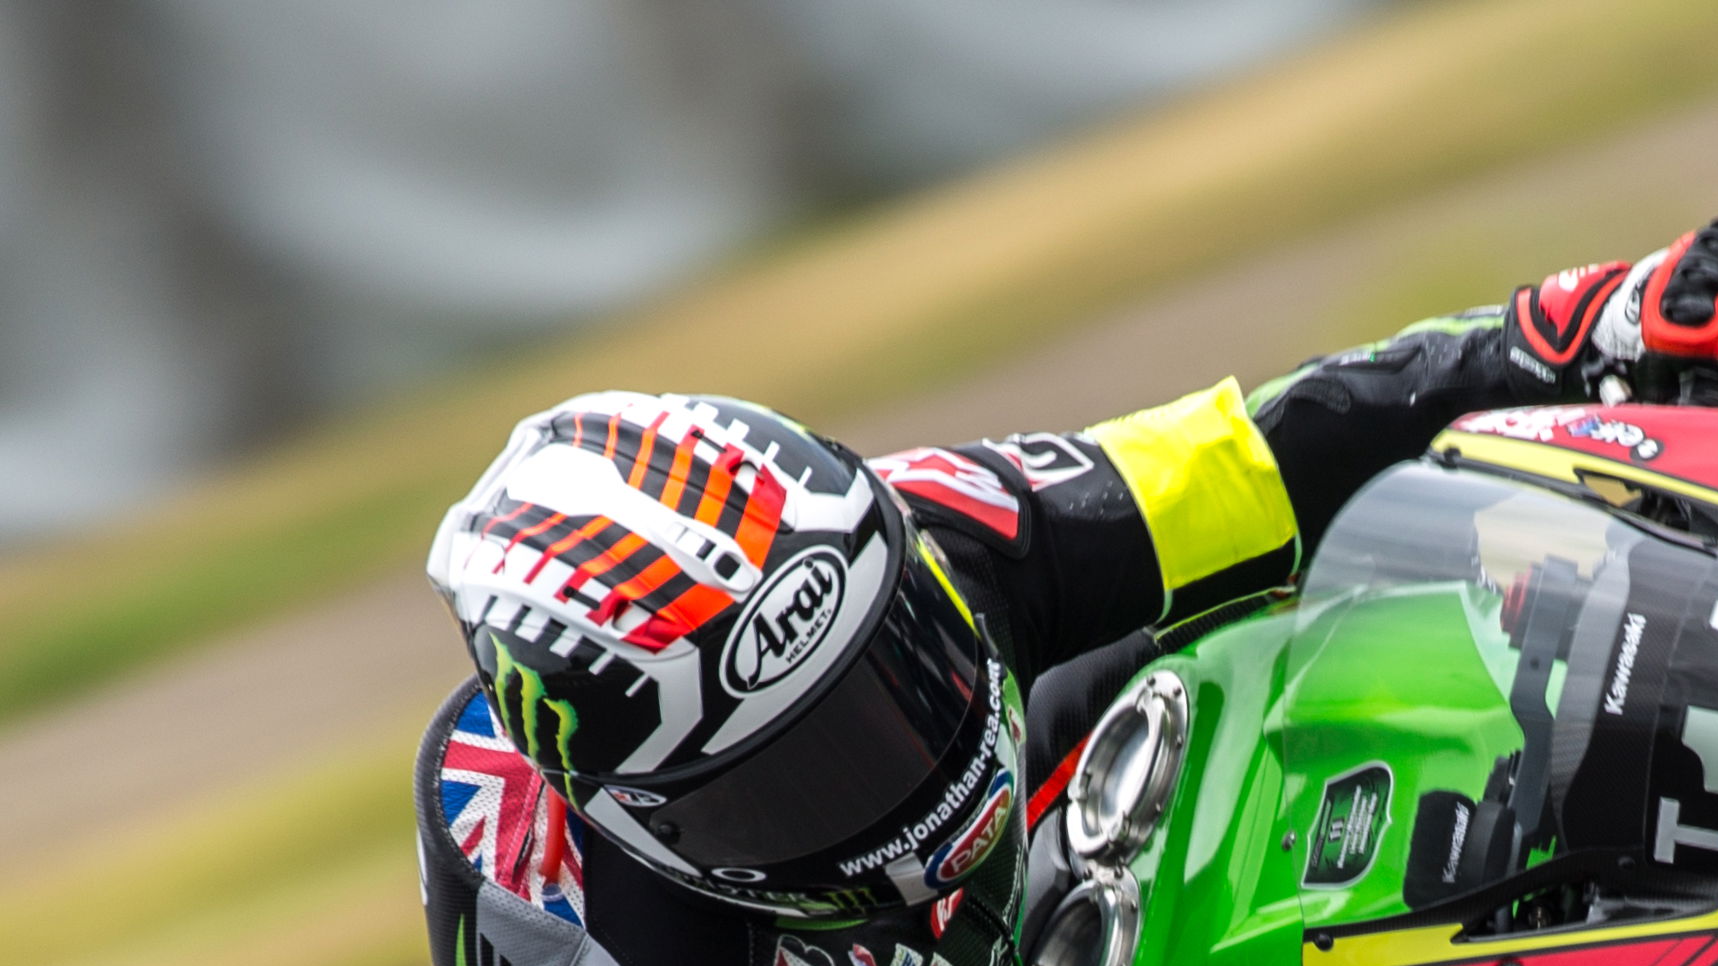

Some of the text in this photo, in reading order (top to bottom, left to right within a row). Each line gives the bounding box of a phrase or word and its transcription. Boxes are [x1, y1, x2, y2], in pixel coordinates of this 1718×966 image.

[746, 557, 833, 690] Arai
[785, 612, 827, 665] HELMET
[1604, 612, 1647, 715] Kawasaki
[838, 657, 1001, 877] www.jonathan-rea.com
[951, 803, 1007, 873] PATA
